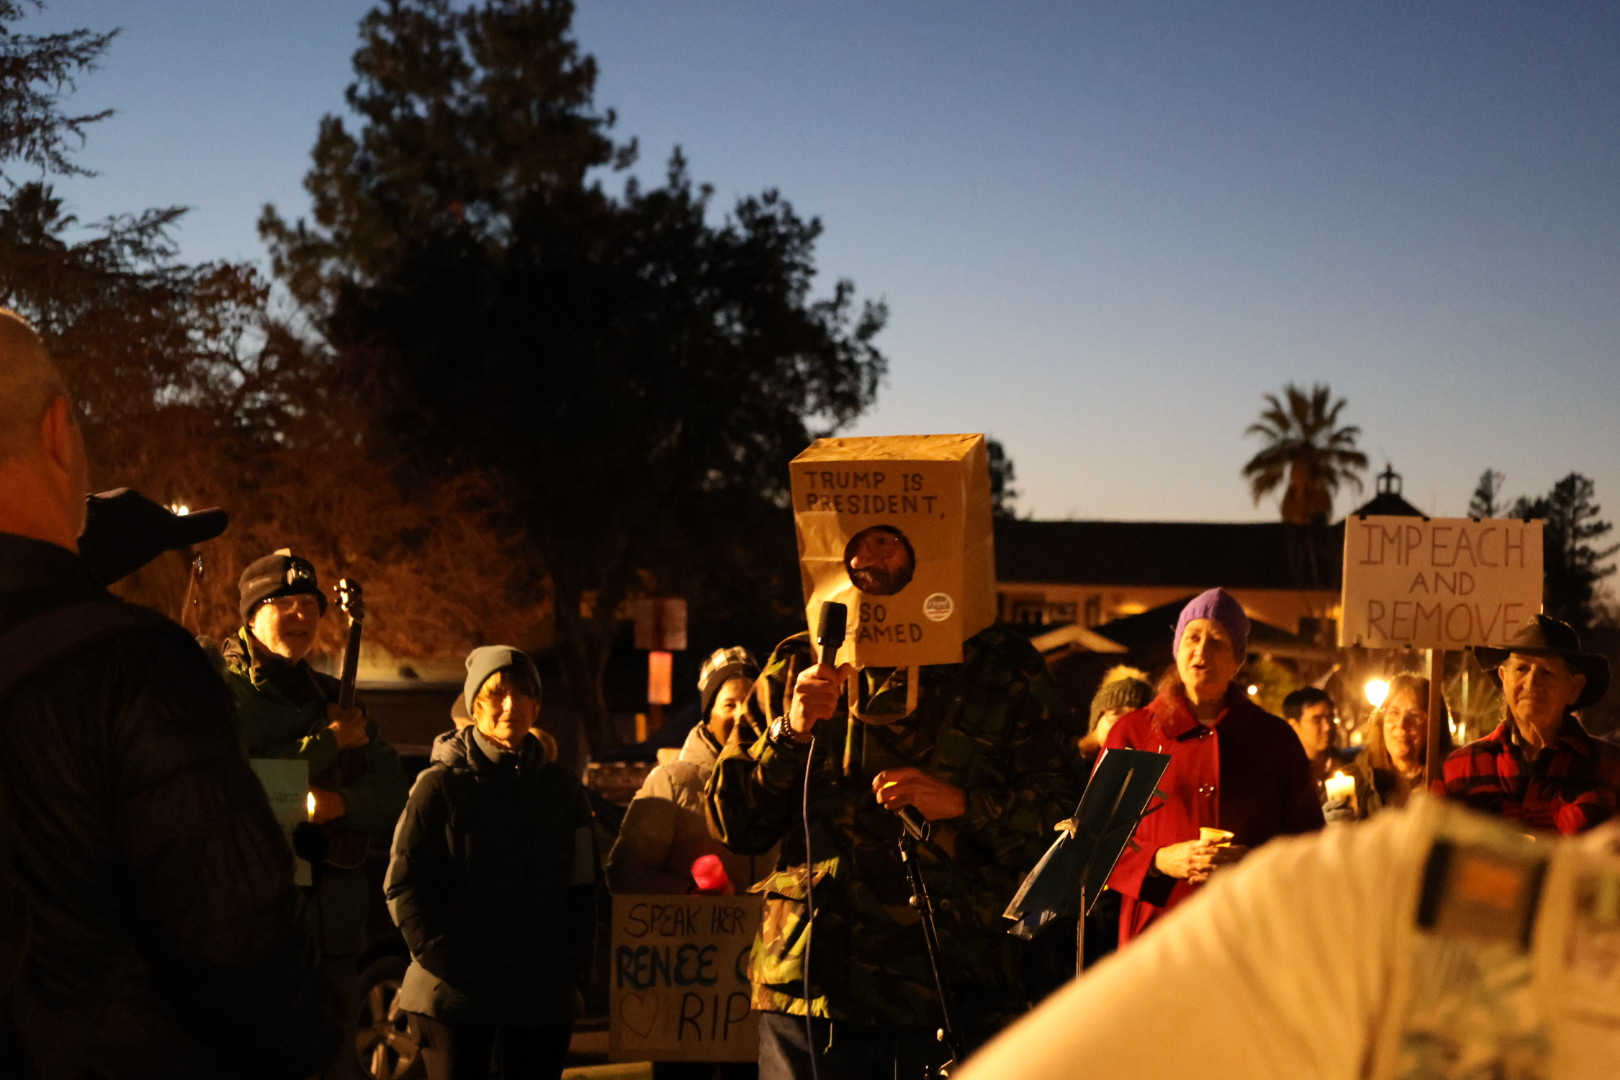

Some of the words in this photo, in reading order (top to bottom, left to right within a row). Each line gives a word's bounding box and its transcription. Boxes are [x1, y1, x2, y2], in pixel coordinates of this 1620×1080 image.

[804, 471, 886, 489] TRUMP
[902, 473, 924, 492] IS
[806, 493, 945, 520] PRESIDENT,
[1359, 523, 1526, 569] IMPEACH
[1409, 571, 1476, 596] AND
[859, 602, 887, 623] SO
[1367, 599, 1524, 643] REMOVE
[624, 903, 699, 938] SPEAK
[711, 905, 745, 936] HER
[616, 943, 719, 990] RENEE
[677, 992, 750, 1041] RIP
